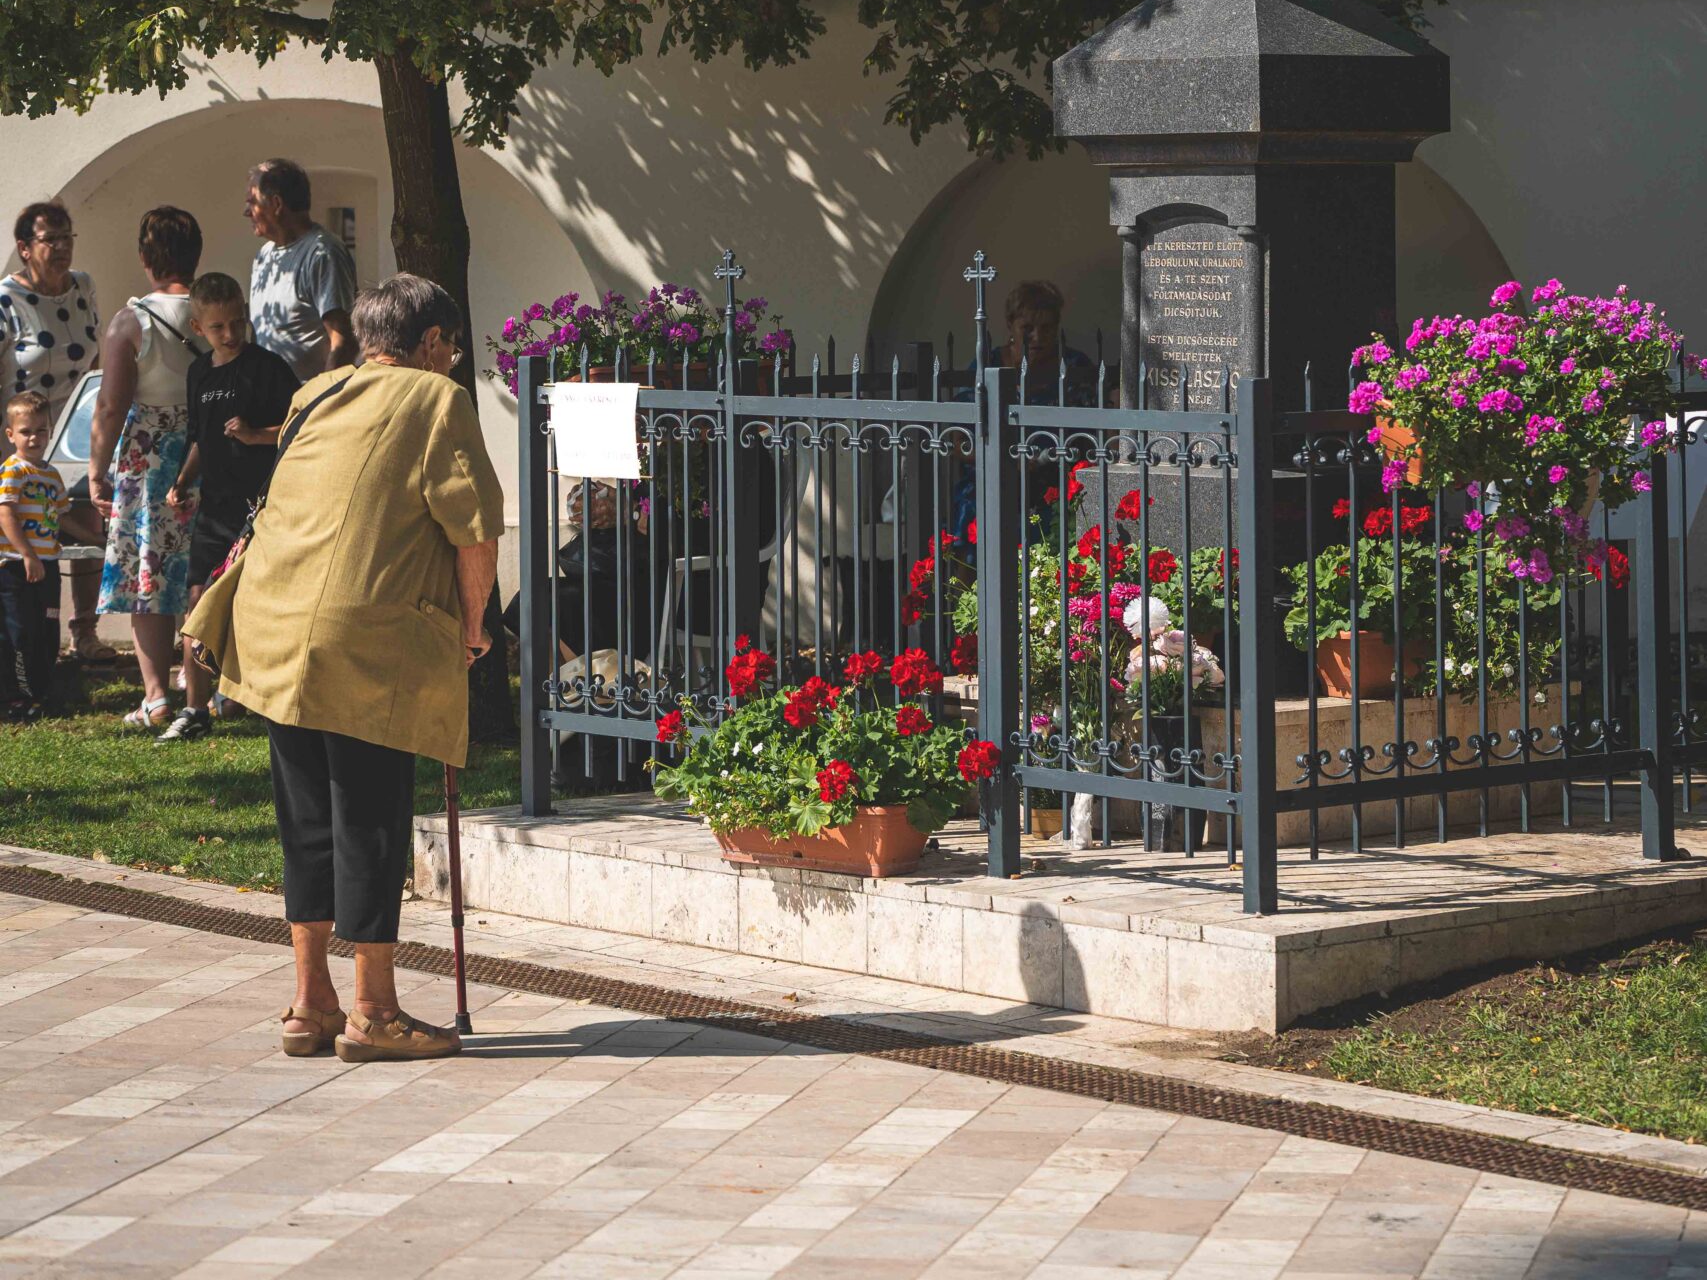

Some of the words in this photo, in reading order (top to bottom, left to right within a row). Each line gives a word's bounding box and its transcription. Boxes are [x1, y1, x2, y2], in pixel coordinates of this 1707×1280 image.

[1152, 242, 1163, 251] TE
[1164, 241, 1214, 251] KERESZTED
[1159, 271, 1171, 284] ÉS
[1174, 275, 1181, 284] A
[1185, 275, 1196, 284] TE
[1200, 275, 1230, 284] SZENT
[1147, 335, 1174, 345] ISTEN
[1162, 349, 1222, 363] EMELTETTÉK
[1147, 367, 1180, 387] KISS
